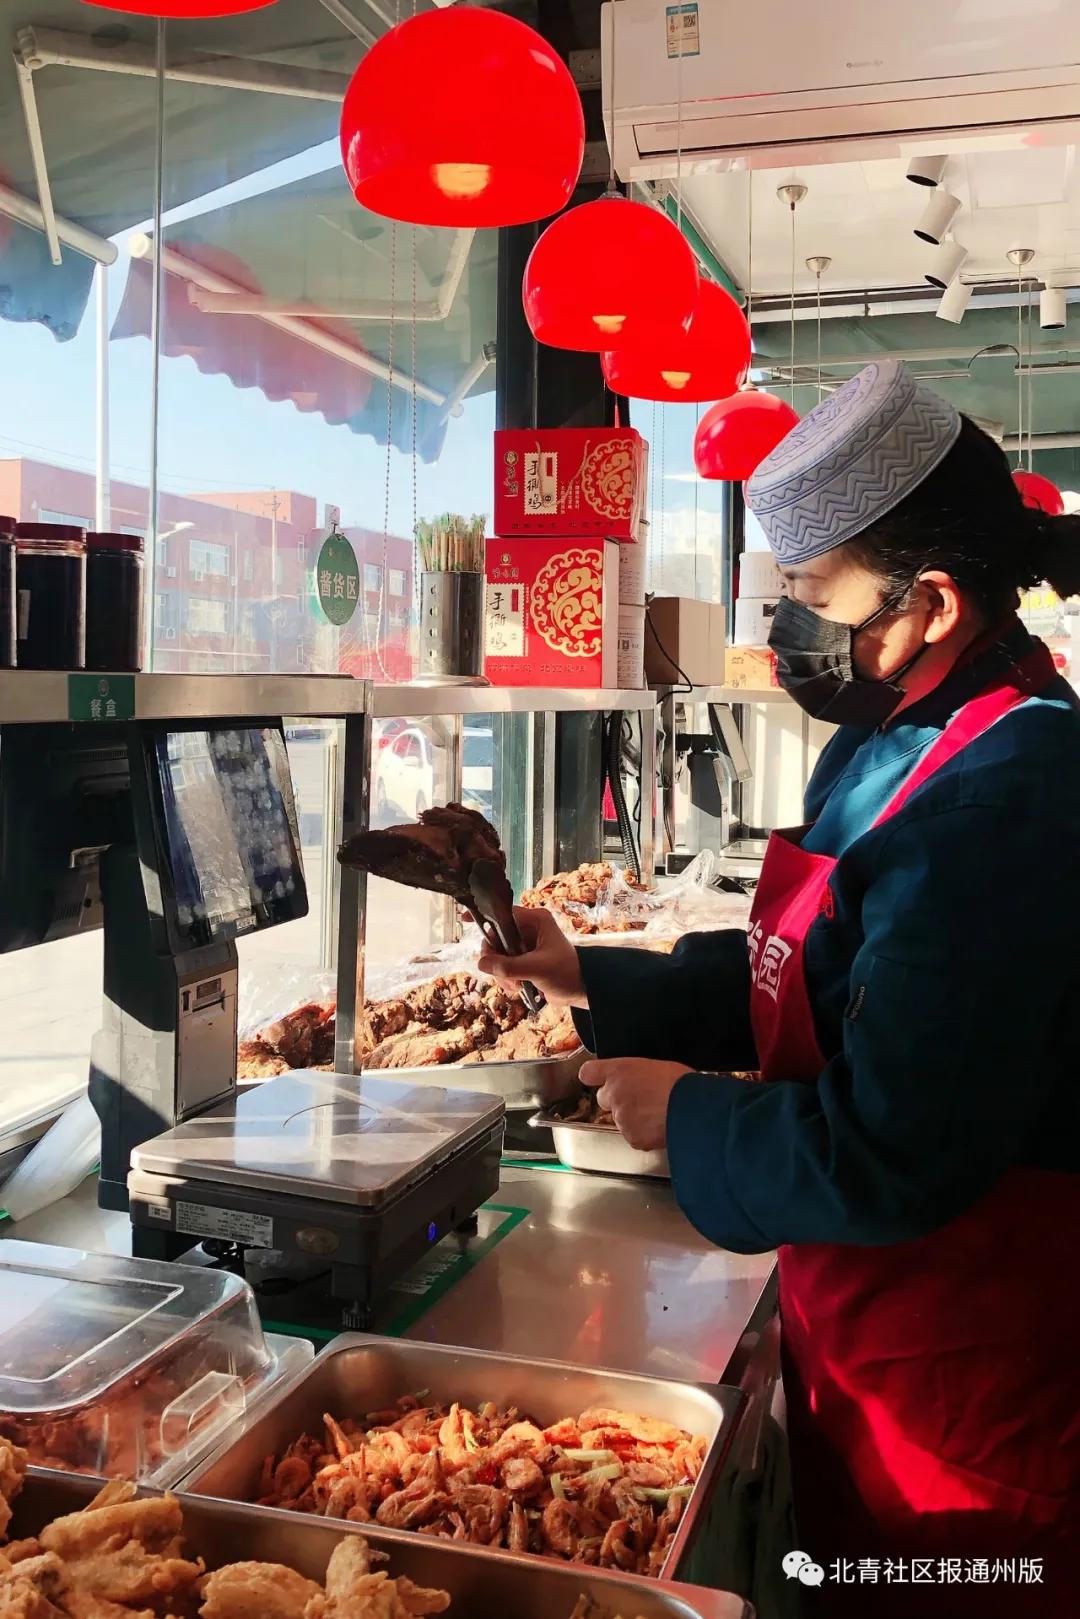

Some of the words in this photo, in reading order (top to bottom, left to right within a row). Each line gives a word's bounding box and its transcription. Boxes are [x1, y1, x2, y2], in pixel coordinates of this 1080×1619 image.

[320, 570, 358, 600] 酱货区
[90, 699, 116, 718] 餐盒
